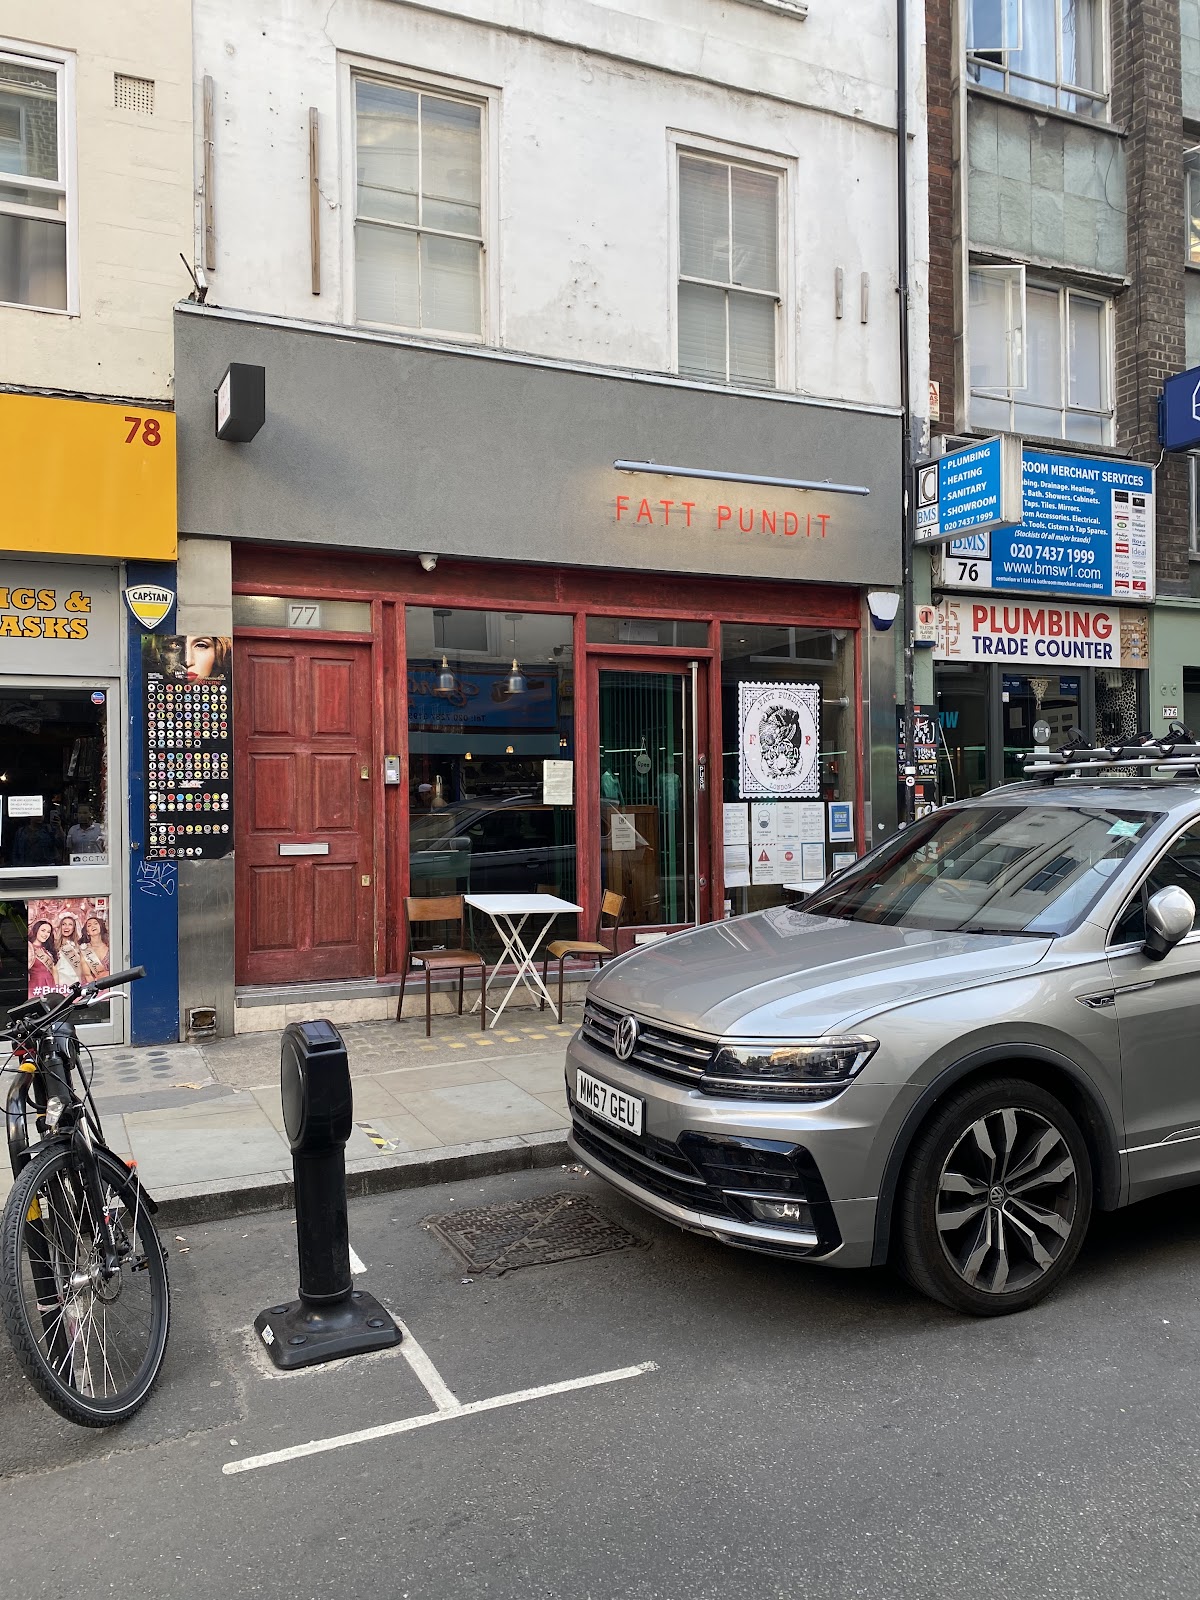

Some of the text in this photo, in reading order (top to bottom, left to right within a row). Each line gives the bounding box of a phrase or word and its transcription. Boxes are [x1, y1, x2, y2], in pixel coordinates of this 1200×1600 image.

[124, 416, 162, 446] 78
[947, 448, 991, 470] PLUMBING
[947, 467, 983, 485] HEATING
[1051, 465, 1100, 481] MERCHANT
[1102, 471, 1144, 487] SERVICES
[947, 482, 987, 501] SANITARY
[1041, 480, 1070, 492] Drainage.
[1070, 484, 1096, 494] Heating.
[947, 495, 997, 517] SHOWROOM
[1024, 500, 1082, 512] Taps. Tiles. Mirrors.
[1028, 490, 1044, 498] Bath.
[1045, 492, 1072, 502] Showers.
[1072, 494, 1101, 504] Cabinets.
[616, 495, 831, 538] FATT PUNDIT
[917, 508, 936, 524] BMS
[944, 511, 994, 531] 020 7437 1999
[1036, 511, 1072, 522] Accessories.
[1072, 516, 1101, 524] Electrical.
[922, 528, 932, 538] 76
[1014, 530, 1040, 538] (Stockists
[1041, 532, 1048, 540] Of
[1055, 534, 1071, 542] major
[1071, 536, 1091, 544] brands)
[1028, 520, 1046, 529] Tools.
[1048, 522, 1068, 532] Cistern
[1076, 526, 1086, 535] Tap
[1086, 528, 1108, 536] Spares.
[952, 532, 986, 551] BMS
[1010, 542, 1095, 564] 020 7437 1999
[958, 562, 979, 582] 76
[1004, 561, 1101, 580] www.bmsw1.com
[64, 590, 92, 613] &
[132, 591, 168, 602] CAPSTAN
[291, 606, 318, 626] 77
[972, 604, 1113, 640] PLUMBING
[972, 636, 1113, 660] TRADE COUNTER
[750, 734, 811, 746] F P
[580, 1075, 635, 1127] MM67 GEU
